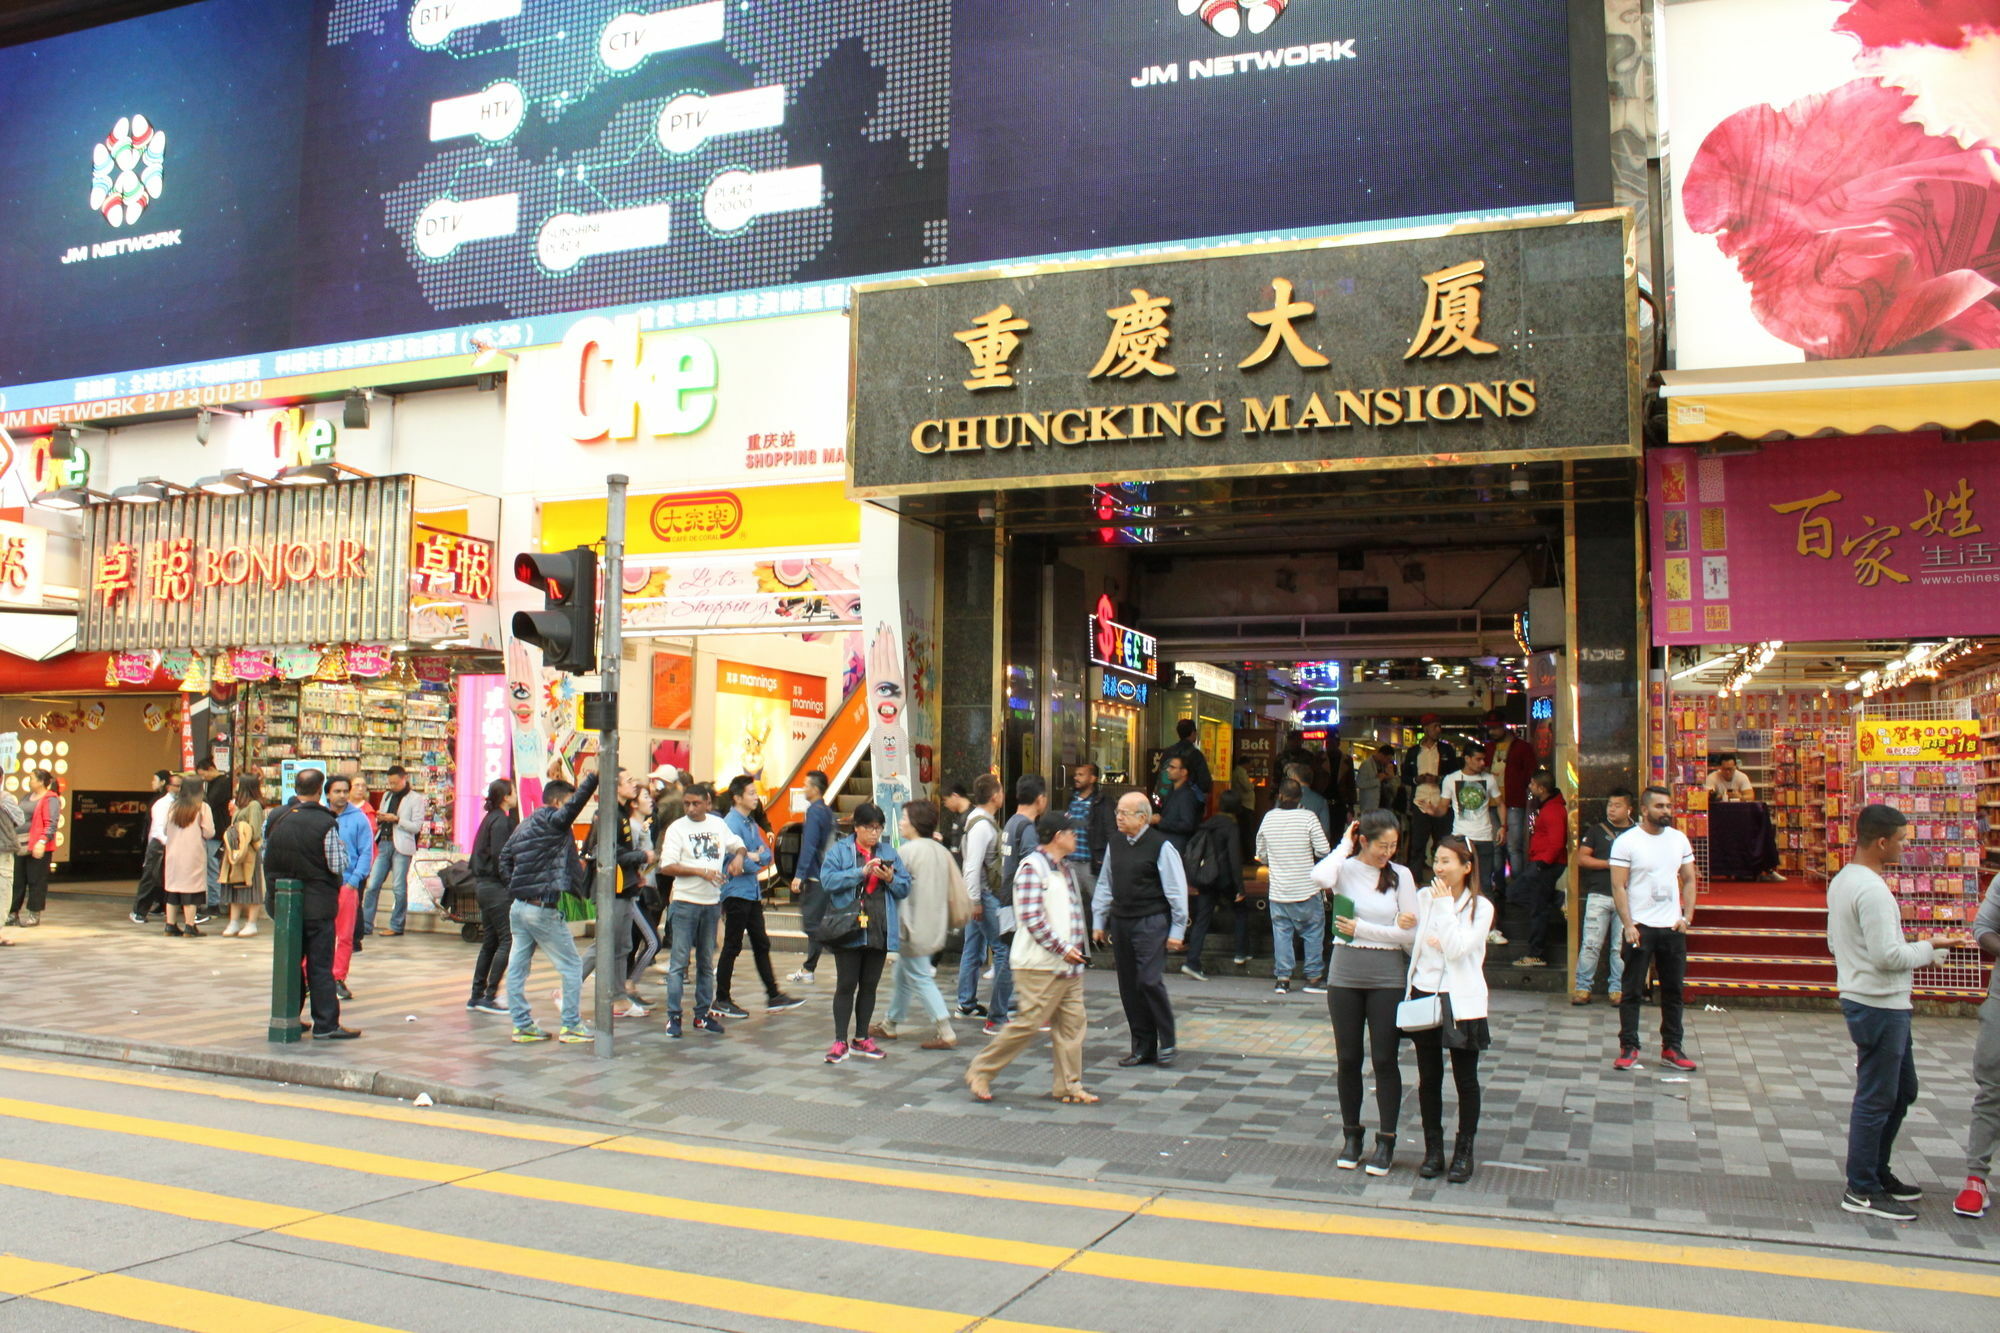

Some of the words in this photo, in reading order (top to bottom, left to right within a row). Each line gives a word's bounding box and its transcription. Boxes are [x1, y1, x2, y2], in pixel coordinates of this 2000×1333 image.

[420, 3, 457, 25] BTV
[608, 29, 647, 52] CTV
[1131, 63, 1178, 87] JM
[1189, 38, 1357, 79] NETWORK
[480, 98, 514, 120] HTV
[671, 109, 712, 132] PTV
[424, 213, 464, 236] DTV
[61, 247, 88, 264] JM
[92, 229, 182, 258] NETWORK
[32, 397, 136, 426] NETWORK
[143, 380, 262, 413] 27230020
[911, 400, 1224, 455] CHUNGKING
[1241, 378, 1537, 434] MANSIONS
[745, 451, 818, 469] SHOPPING
[1769, 478, 1983, 587] 百家姓
[203, 537, 367, 592] BONJOUR
[1920, 542, 2000, 567] 生活
[739, 674, 778, 692] mannings
[792, 698, 824, 714] mannings
